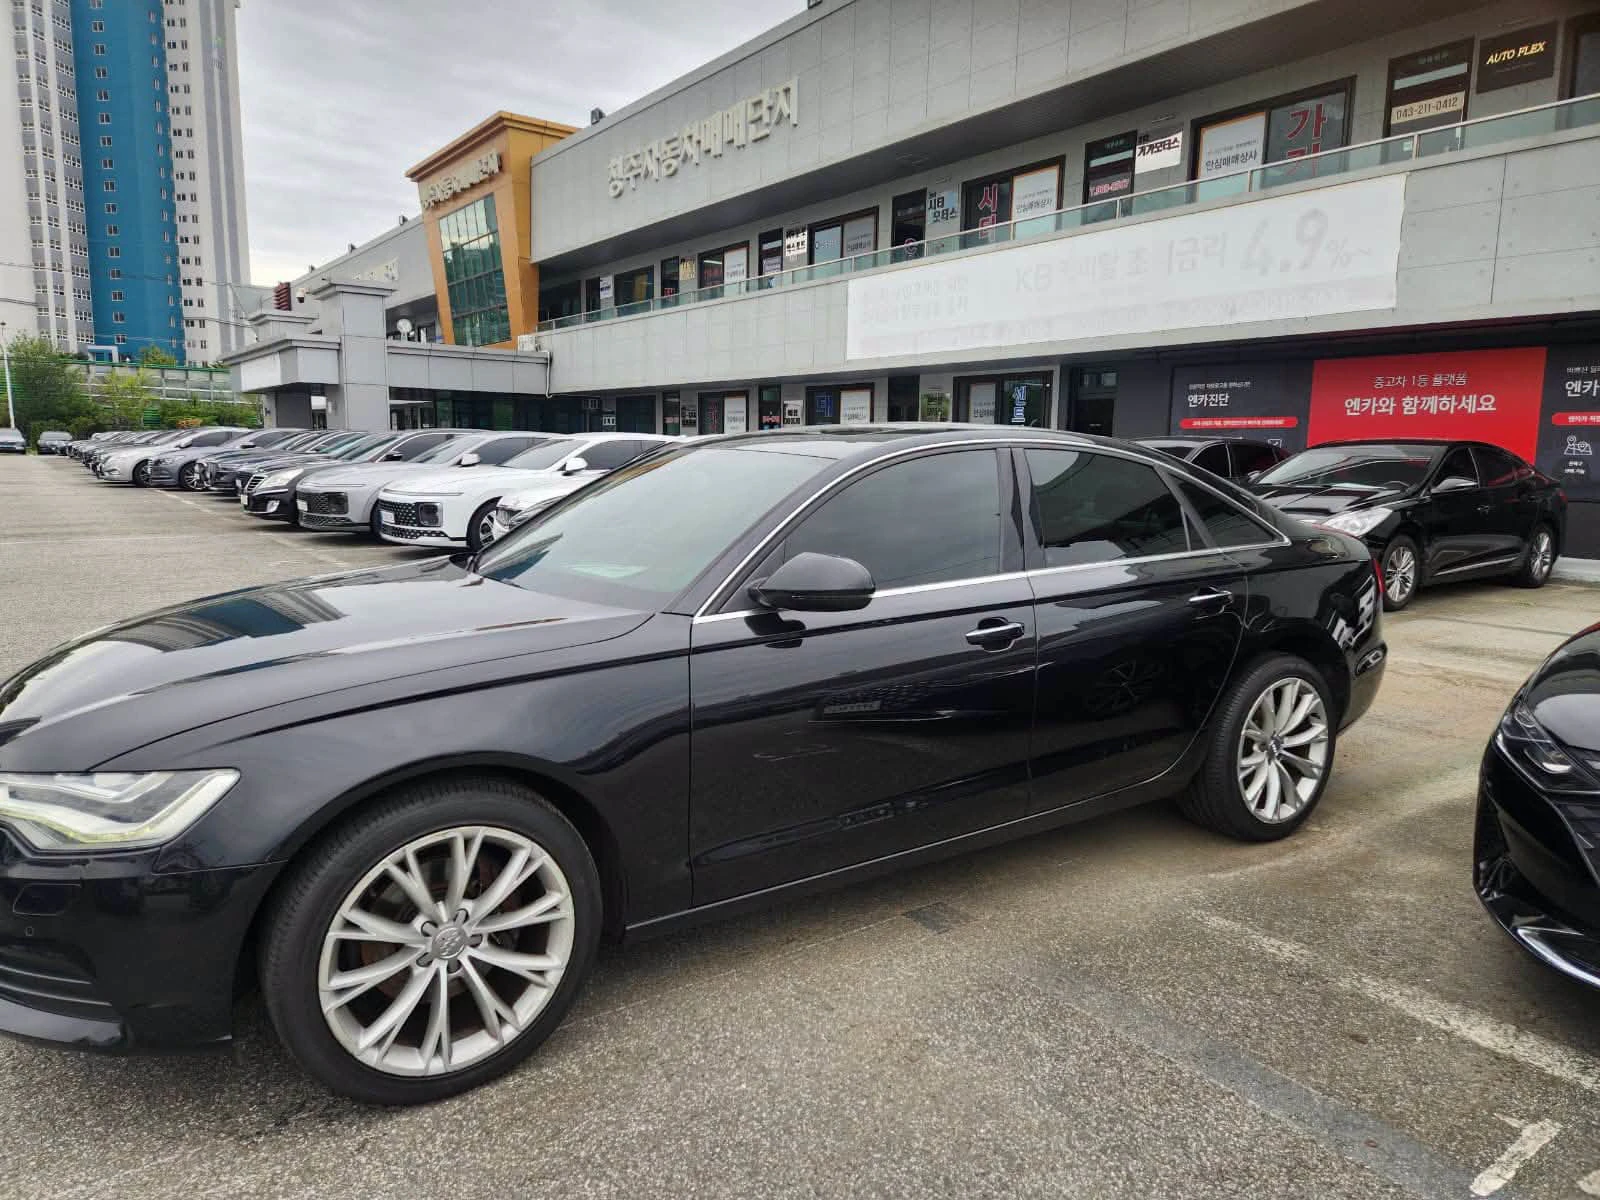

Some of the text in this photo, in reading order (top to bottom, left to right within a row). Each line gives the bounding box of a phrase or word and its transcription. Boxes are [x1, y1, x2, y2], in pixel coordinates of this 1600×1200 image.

[1486, 49, 1515, 65] AUTO
[1396, 96, 1458, 120] 043-211-0412
[608, 77, 800, 199] 청주자동차매매단지
[1205, 149, 1257, 171] 안심매매상사
[1374, 372, 1468, 388] 중고차 1등 플랫폼
[1188, 393, 1230, 408] 엔카진단
[1344, 394, 1497, 416] 엔카와 함께하세요
